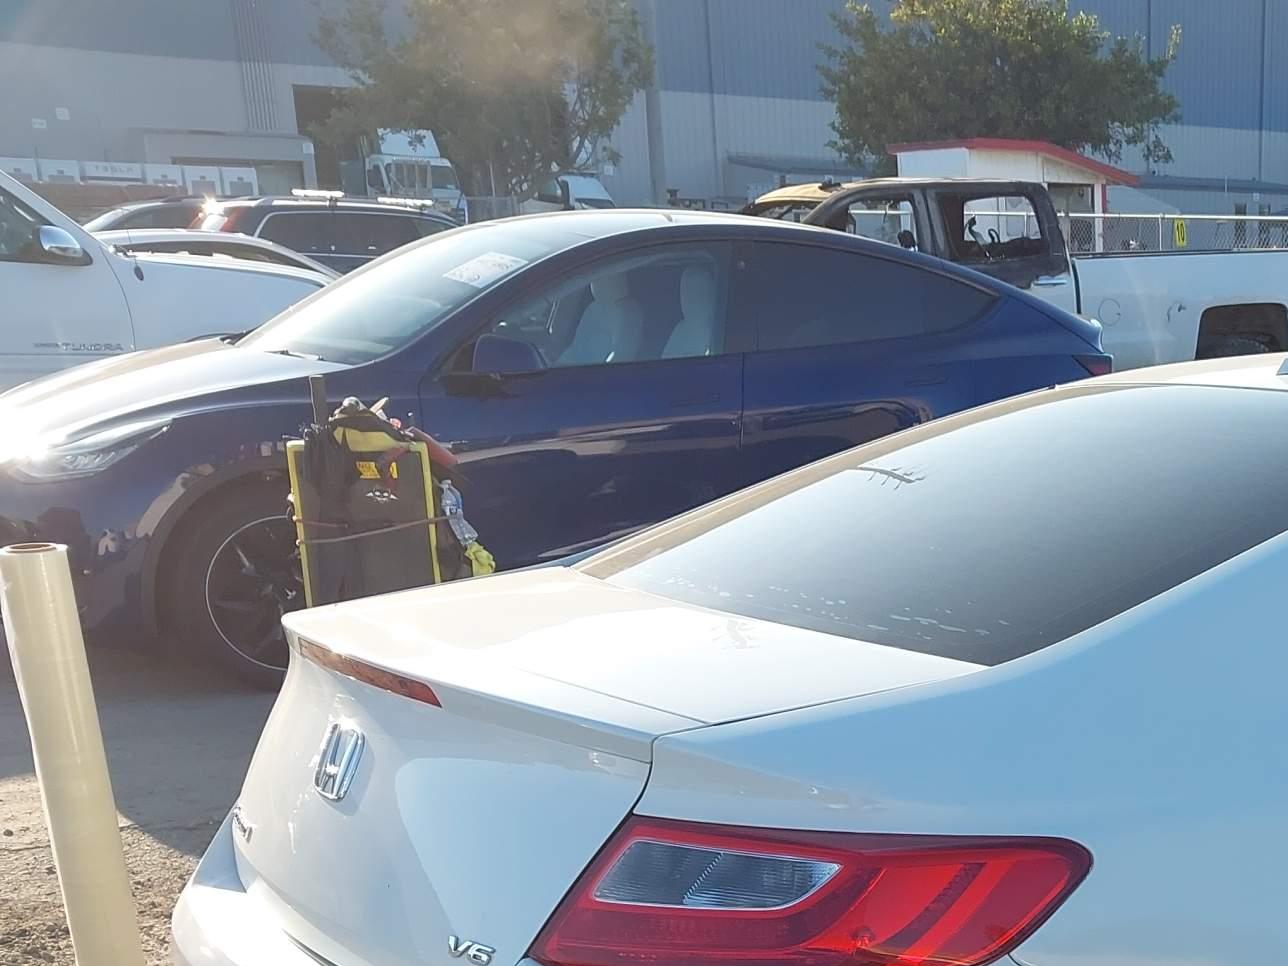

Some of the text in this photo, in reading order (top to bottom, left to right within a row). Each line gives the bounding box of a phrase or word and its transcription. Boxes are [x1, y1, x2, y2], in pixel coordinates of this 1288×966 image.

[1176, 221, 1185, 243] 10
[62, 342, 124, 352] TUNDRA
[448, 935, 496, 966] V6
